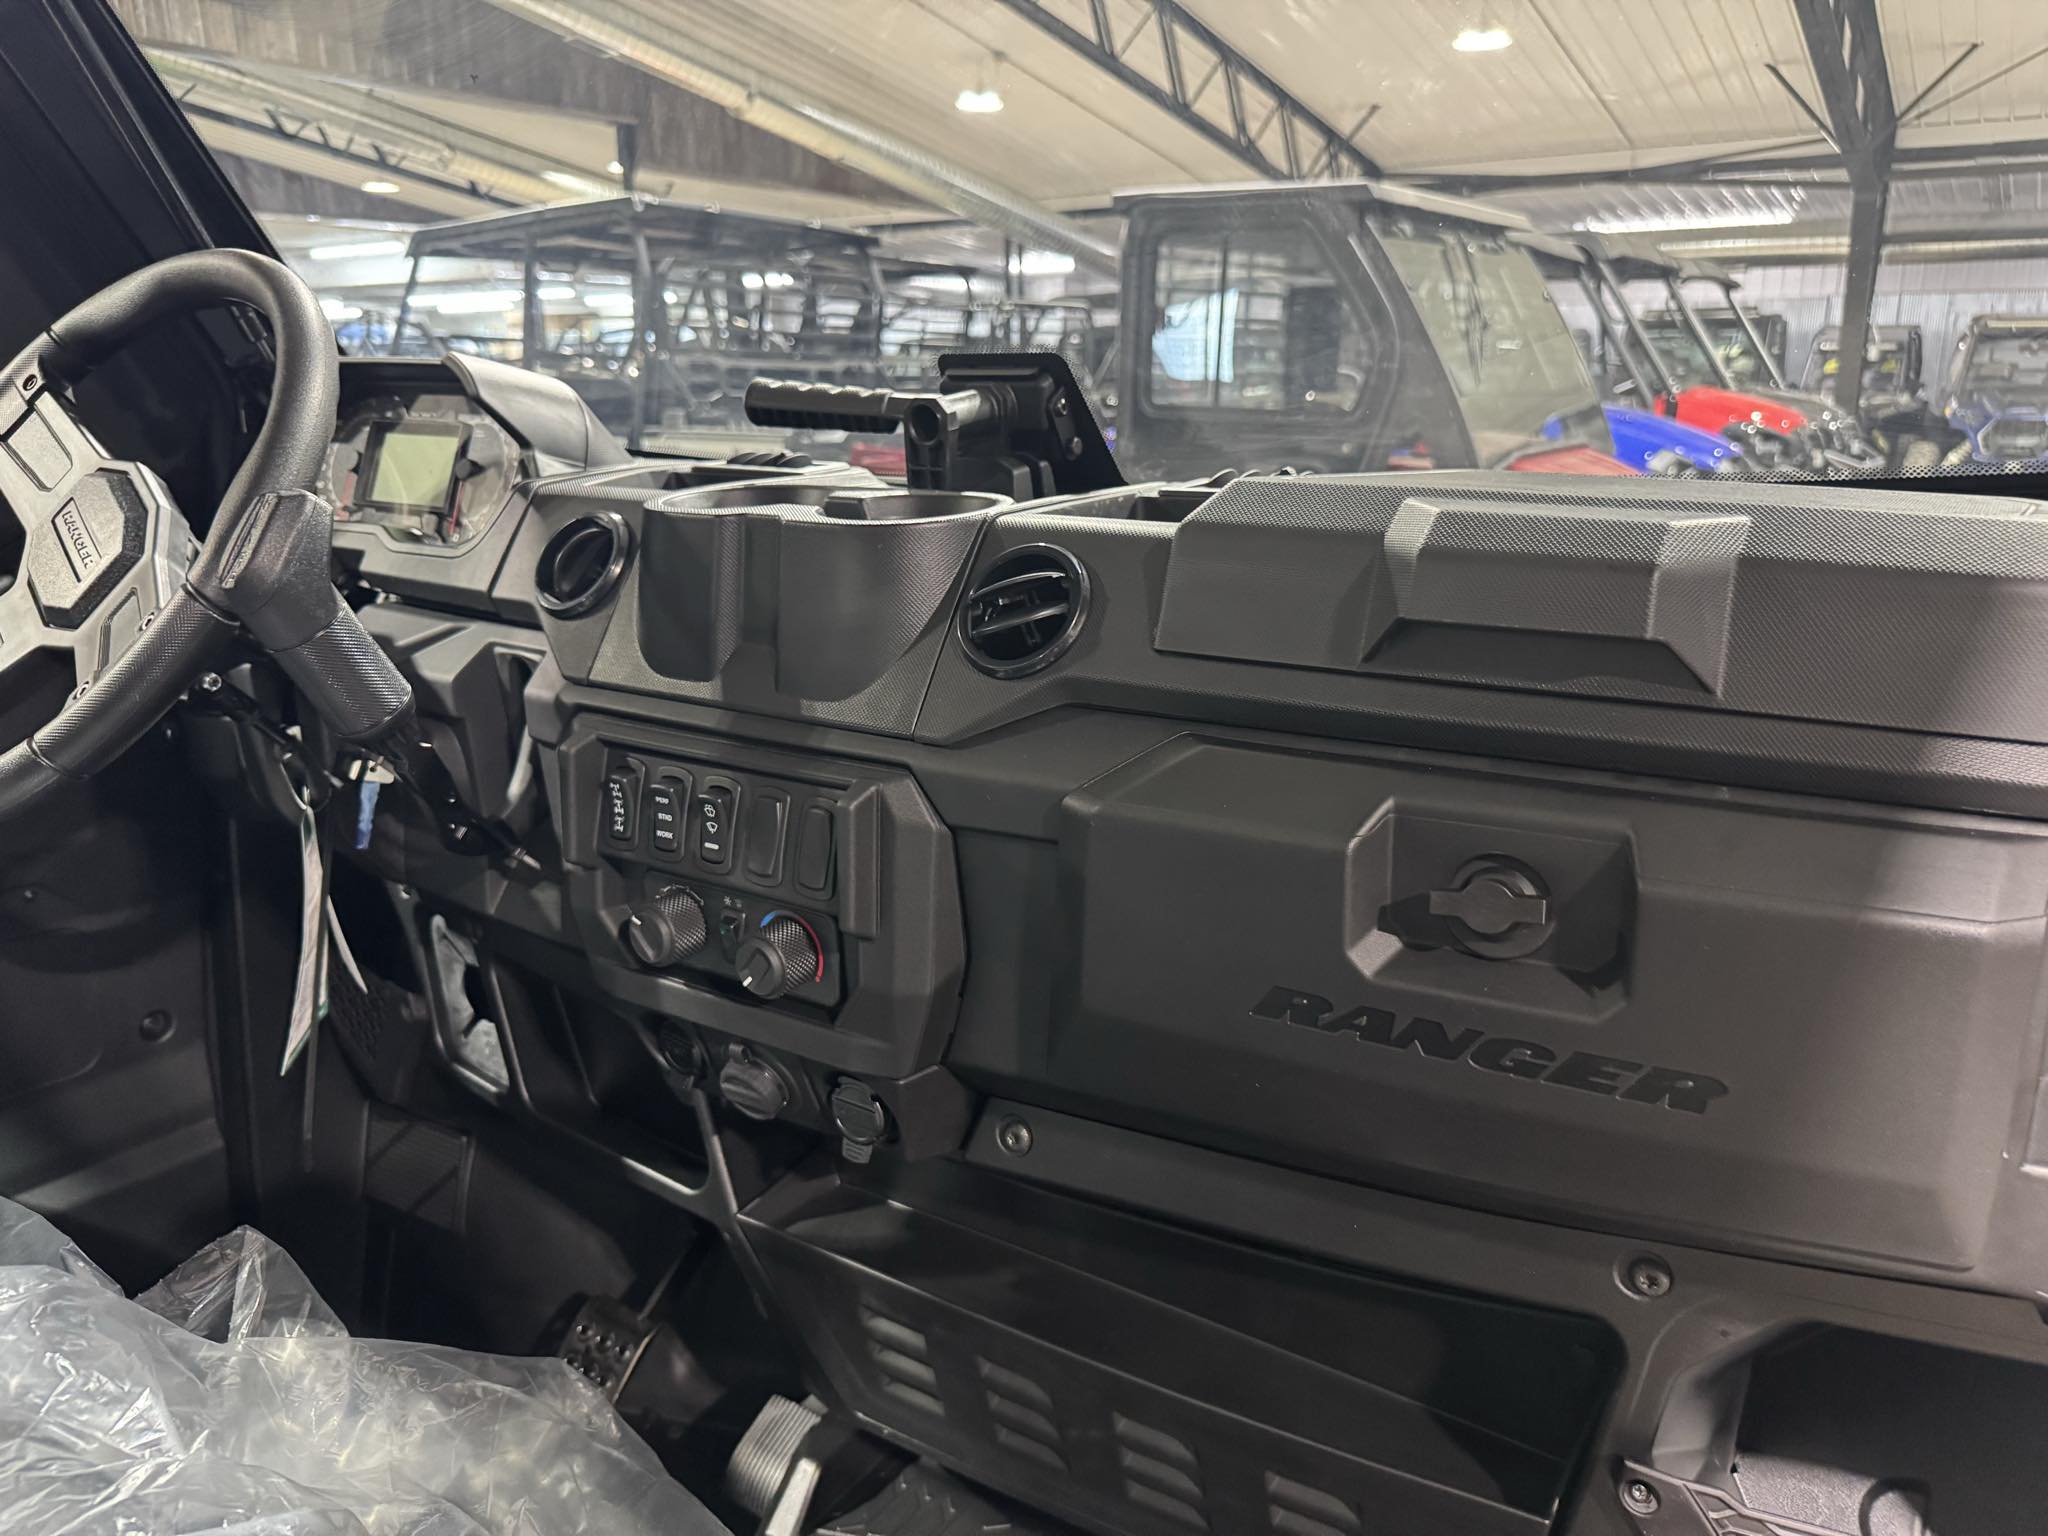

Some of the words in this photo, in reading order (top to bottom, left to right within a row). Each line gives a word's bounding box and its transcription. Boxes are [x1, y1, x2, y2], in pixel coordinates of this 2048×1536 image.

[62, 510, 93, 570] RANGER
[656, 830, 673, 840] WORK
[1249, 985, 1729, 1115] RANGER
